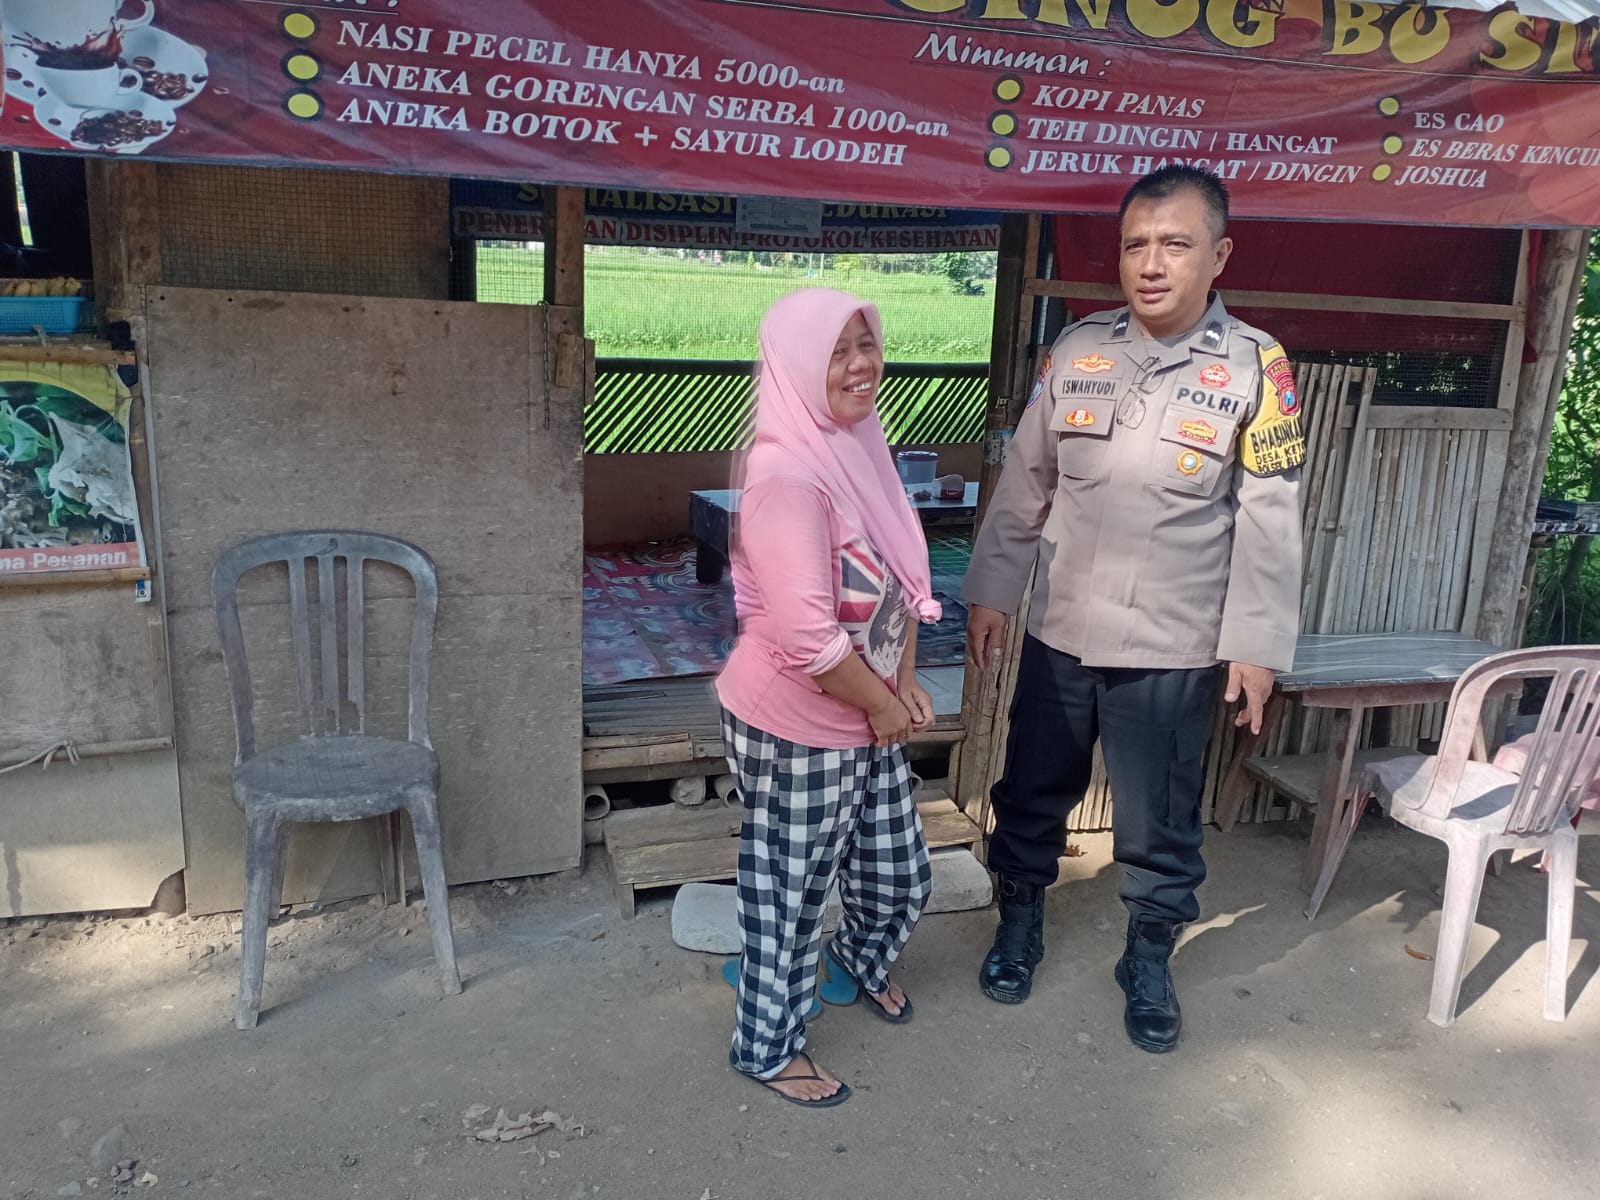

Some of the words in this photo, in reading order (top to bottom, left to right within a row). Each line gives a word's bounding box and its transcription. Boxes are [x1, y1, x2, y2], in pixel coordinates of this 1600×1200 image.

[337, 20, 433, 53] NASI
[443, 30, 572, 66] PECEL
[582, 45, 702, 80] HANYA
[714, 58, 845, 94] 5000-an
[914, 32, 1089, 76] Minuman
[1479, 9, 1600, 73] SI
[337, 61, 471, 95] ANEKA
[485, 74, 696, 116] GORENGAN
[705, 95, 815, 127] SERBA
[827, 106, 950, 137] 1000-an
[1031, 85, 1110, 112] KOPI
[1114, 93, 1206, 119] PANAS
[337, 98, 470, 132] ANEKA
[482, 110, 621, 144] BOTOK
[634, 126, 658, 147] +
[671, 126, 781, 158] SAYUR
[790, 136, 907, 166] LODEH
[1026, 117, 1089, 143] TEH
[1095, 122, 1203, 150] DINGIN
[1225, 132, 1339, 155] HANGAT
[1414, 112, 1445, 130] ES
[1454, 113, 1505, 133] CAO
[1020, 150, 1124, 175] JERUK
[1263, 162, 1363, 184] DINGIN
[1408, 139, 1440, 158] ES
[1442, 141, 1520, 162] BERAS
[1395, 166, 1487, 188] JOSHUA
[625, 222, 733, 245] DISIPLIN
[870, 228, 998, 248] KESEHATAN
[1062, 378, 1116, 396] ISWAHYUDI
[1176, 387, 1239, 415] POLRI
[32, 551, 127, 569] Pesanan
